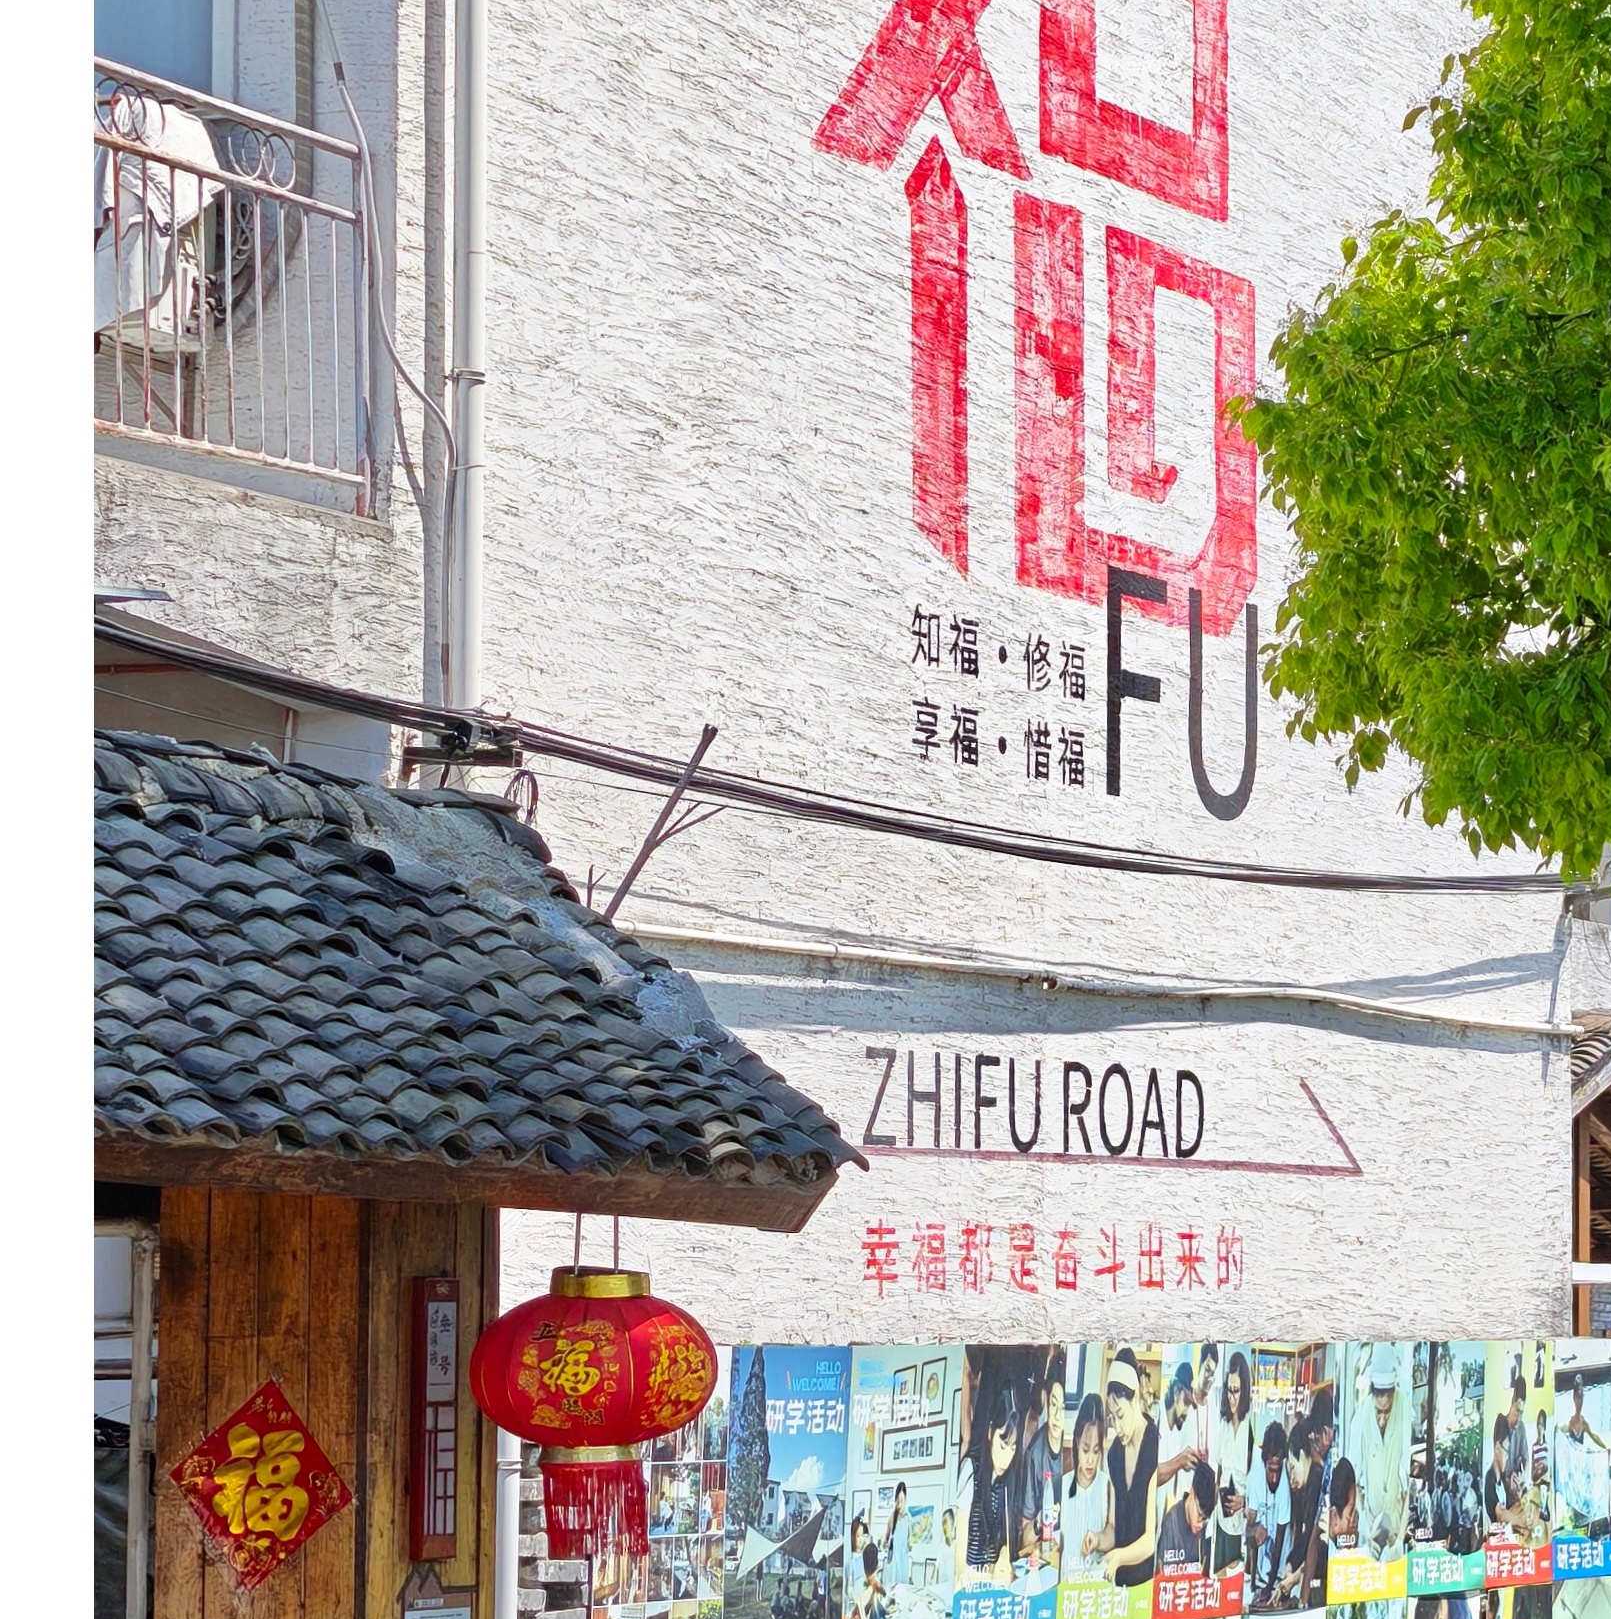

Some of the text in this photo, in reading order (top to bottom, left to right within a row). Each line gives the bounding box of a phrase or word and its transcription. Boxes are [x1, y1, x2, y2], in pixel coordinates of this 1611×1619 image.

[1106, 564, 1258, 821] FU
[864, 1046, 1205, 1158] ZHIFU ROAD
[861, 1218, 1244, 1300] 幸福都是奋斗出来的
[815, 1360, 842, 1374] HELLO
[766, 1397, 845, 1434] 研学活动
[853, 1394, 929, 1428] 研学活动
[212, 1422, 309, 1541] 福
[1164, 1549, 1185, 1562] HELLO
[1412, 1553, 1464, 1586] 研学活动
[1486, 1547, 1536, 1578] 研学活动
[1557, 1541, 1604, 1571] 研学活动
[1159, 1578, 1221, 1613] 研学活动
